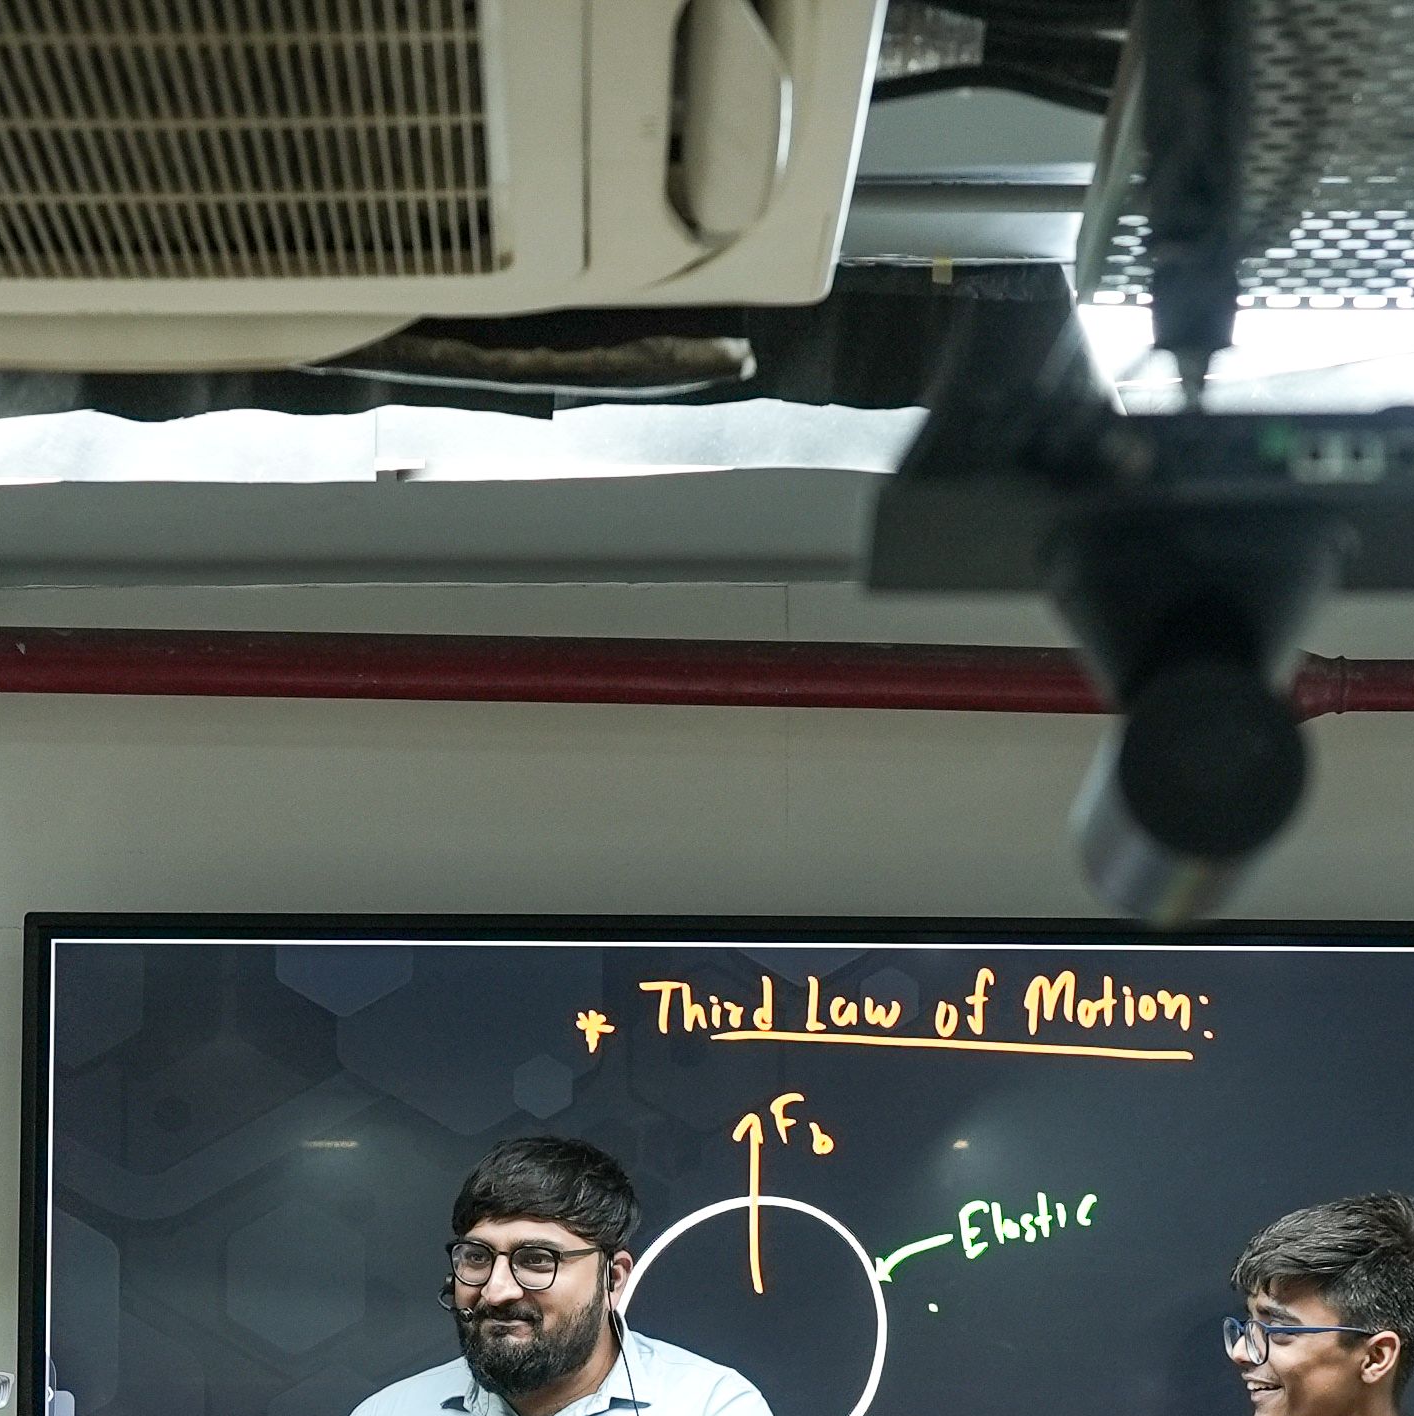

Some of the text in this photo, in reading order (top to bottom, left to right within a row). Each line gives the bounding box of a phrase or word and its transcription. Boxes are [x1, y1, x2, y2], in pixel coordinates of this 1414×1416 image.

[639, 967, 1214, 1040] Third Law of Motion:
[958, 1191, 1098, 1260] Elastic
